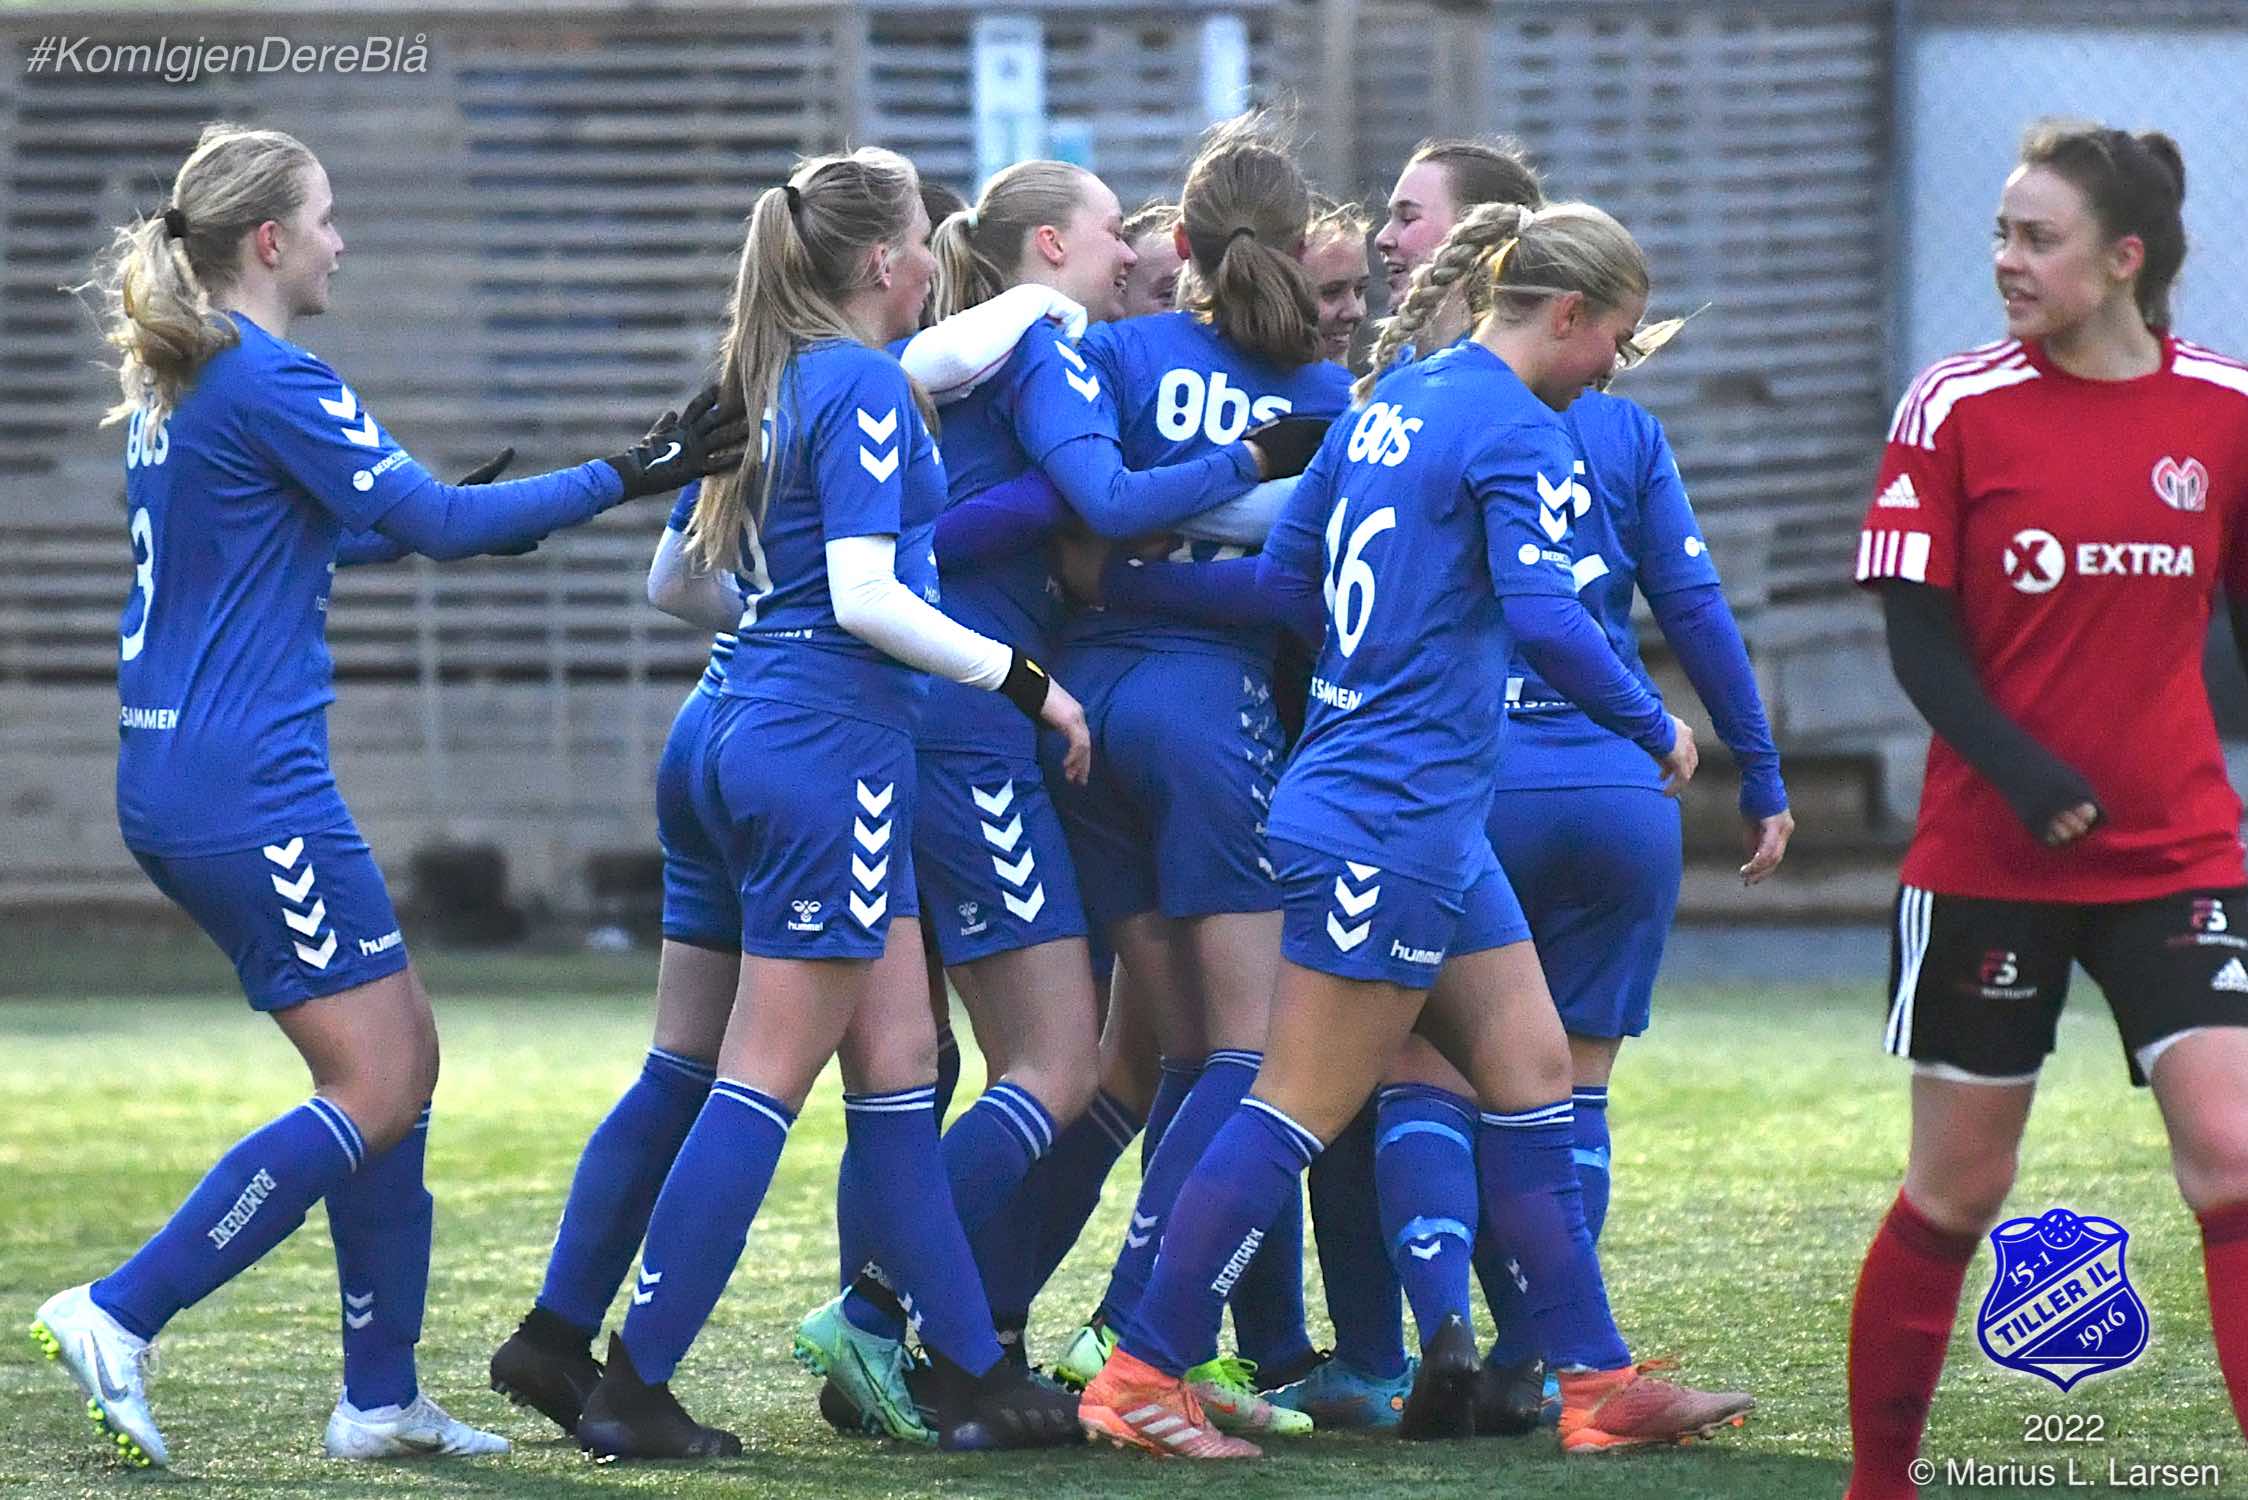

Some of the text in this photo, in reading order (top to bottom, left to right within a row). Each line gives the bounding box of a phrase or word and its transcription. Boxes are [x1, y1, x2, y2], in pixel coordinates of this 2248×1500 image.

[2076, 543, 2196, 577] EXTRA
[121, 506, 155, 661] 3
[788, 919, 824, 932] hummel
